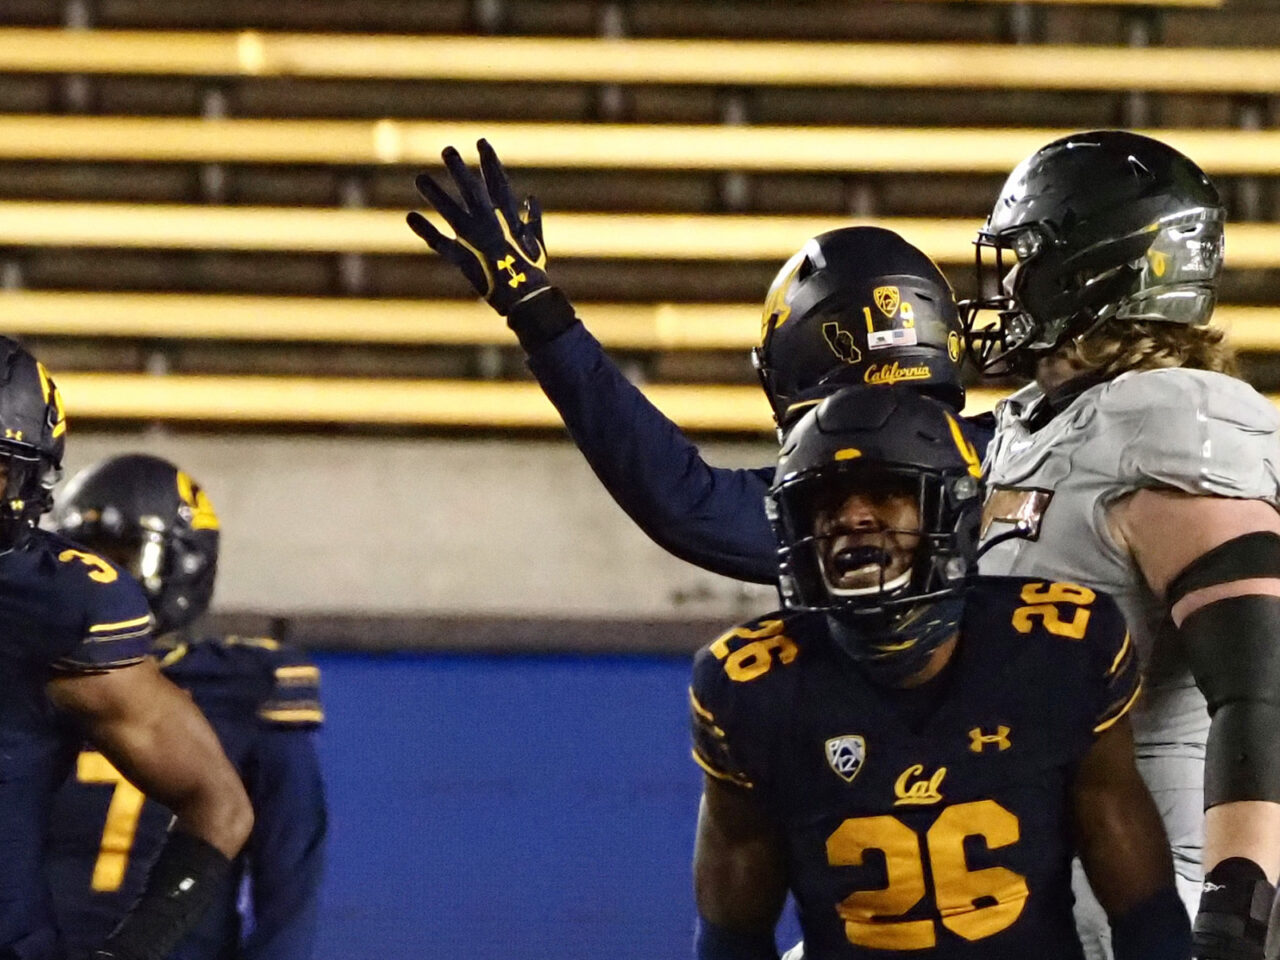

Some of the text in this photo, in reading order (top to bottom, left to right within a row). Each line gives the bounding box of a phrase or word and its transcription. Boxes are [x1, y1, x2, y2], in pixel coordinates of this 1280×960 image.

[864, 361, 932, 385] California
[58, 549, 118, 584] 3
[1012, 582, 1097, 641] 26
[709, 619, 800, 683] 26
[893, 764, 947, 805] Cal
[825, 799, 1030, 952] 26
